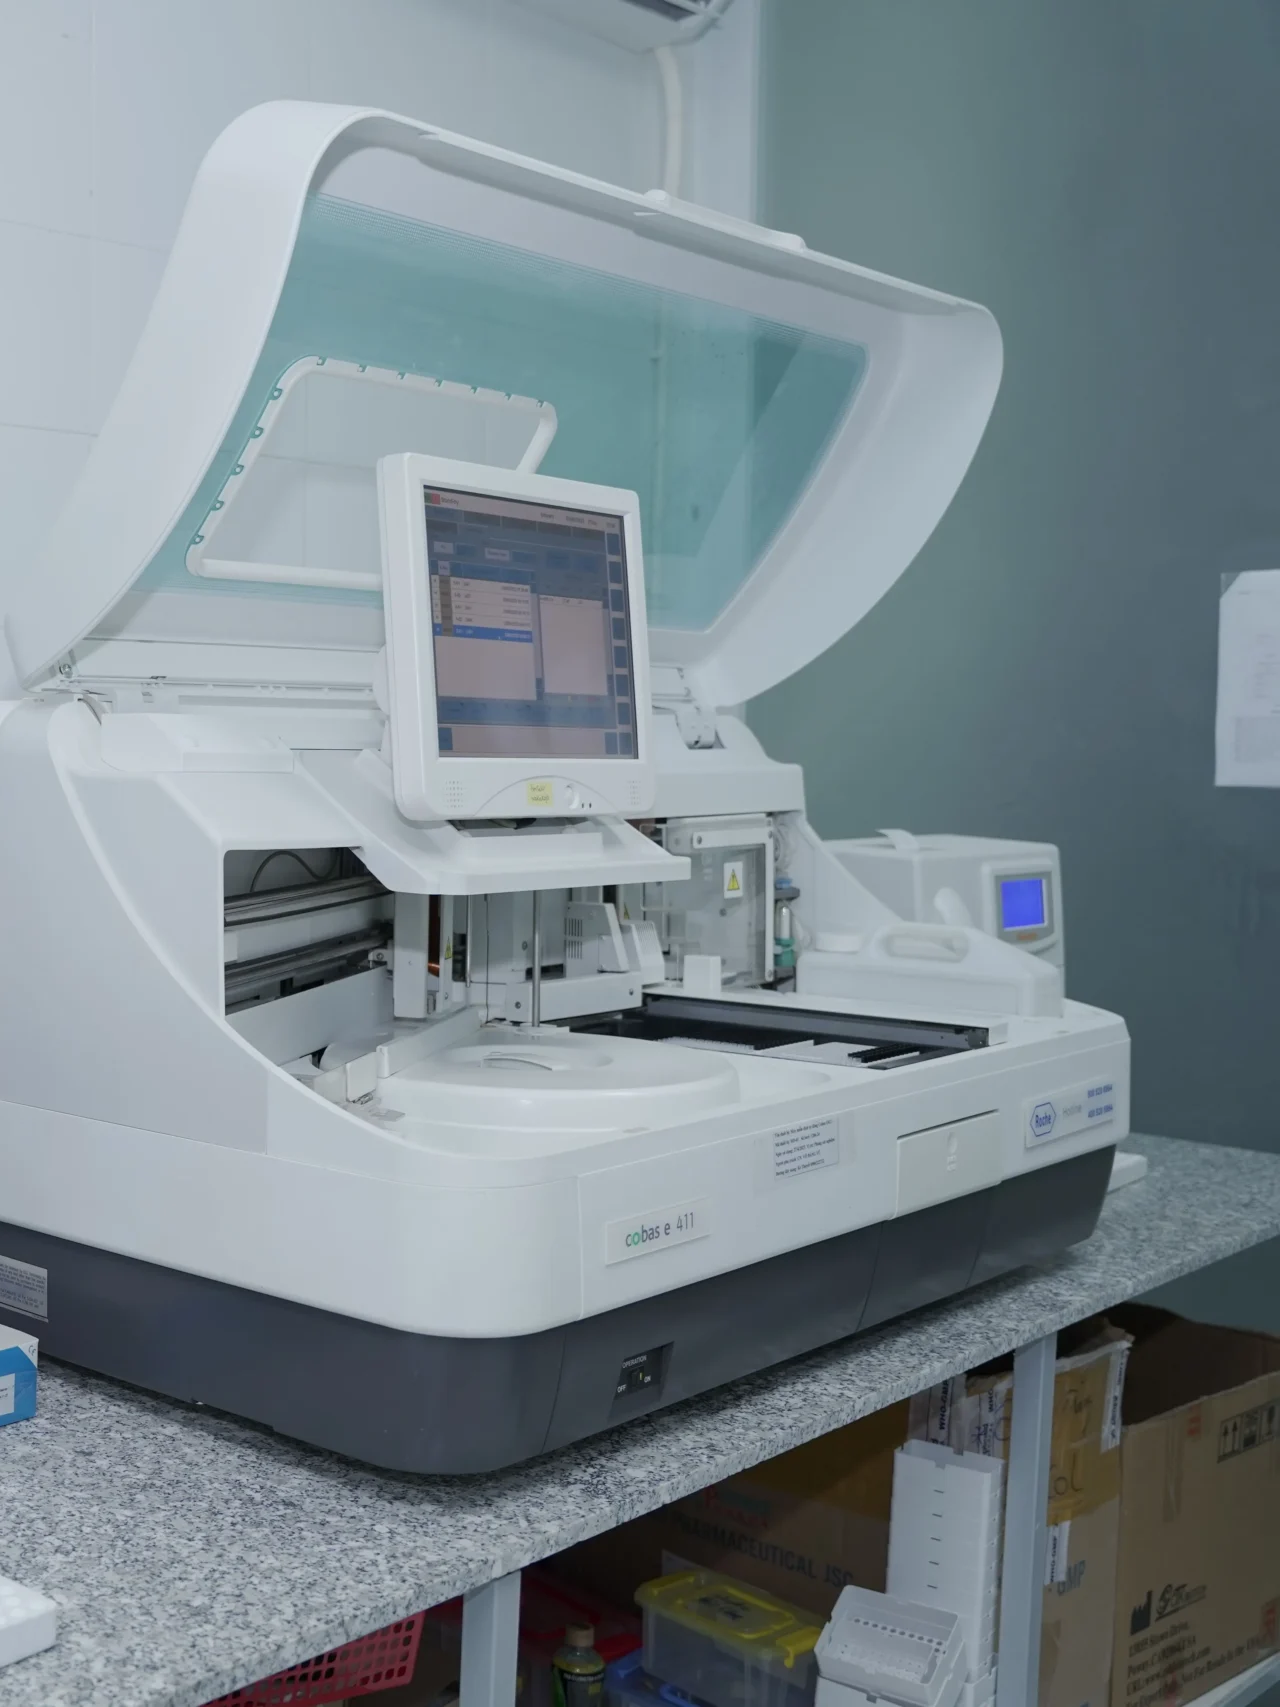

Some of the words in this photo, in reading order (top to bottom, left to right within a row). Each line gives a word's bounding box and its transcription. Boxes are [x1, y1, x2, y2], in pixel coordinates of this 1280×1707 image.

[1035, 1112, 1051, 1128] Roche
[625, 1224, 660, 1248] cobas
[664, 1222, 671, 1236] e
[676, 1212, 694, 1231] 411
[622, 1355, 647, 1369] OPERATION
[644, 1375, 651, 1383] ON
[617, 1384, 627, 1393] OFF
